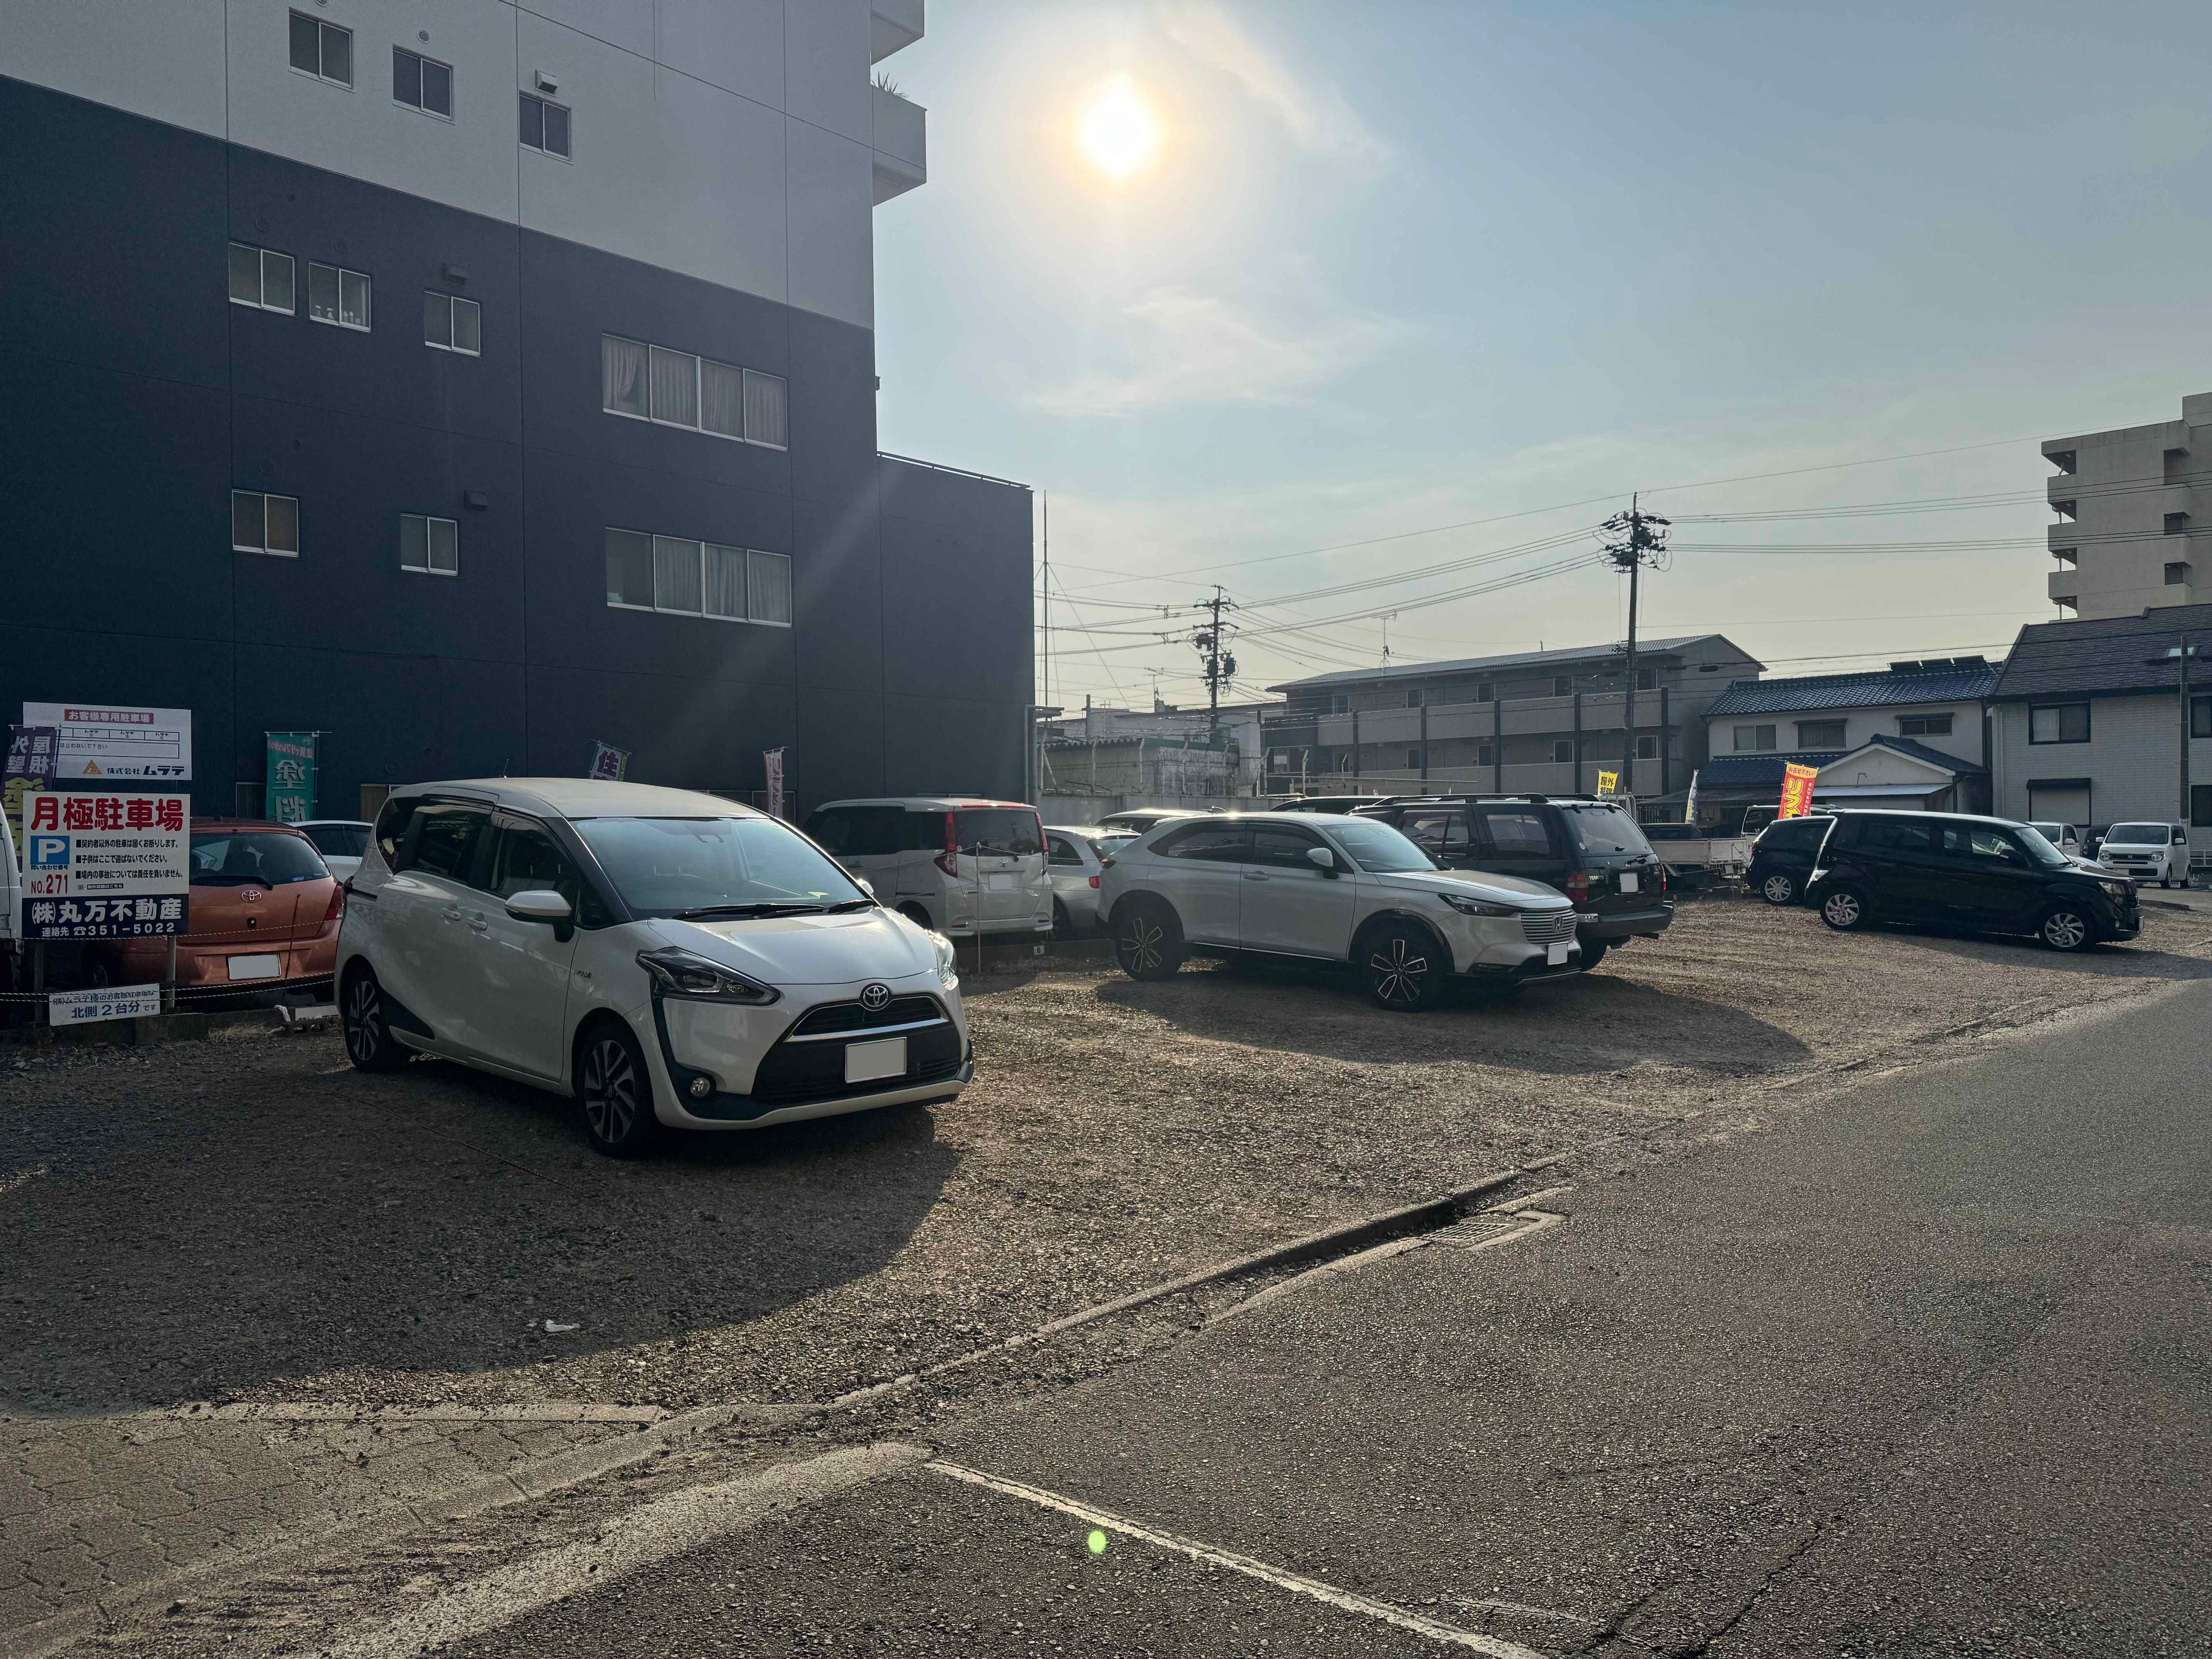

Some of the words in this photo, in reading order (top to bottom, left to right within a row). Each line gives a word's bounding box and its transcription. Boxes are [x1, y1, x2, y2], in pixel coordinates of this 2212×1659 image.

[69, 710, 150, 723] お客様専用駐車場
[143, 765, 184, 775] ムラテ
[31, 797, 184, 832] 月極駐車場
[38, 839, 66, 862] P
[82, 854, 167, 863] 子供はここで遊ばないでください。
[81, 869, 183, 879] 場内の事故については責任を負いません。
[41, 926, 69, 937] 連絡先
[88, 922, 175, 935] 351-5022
